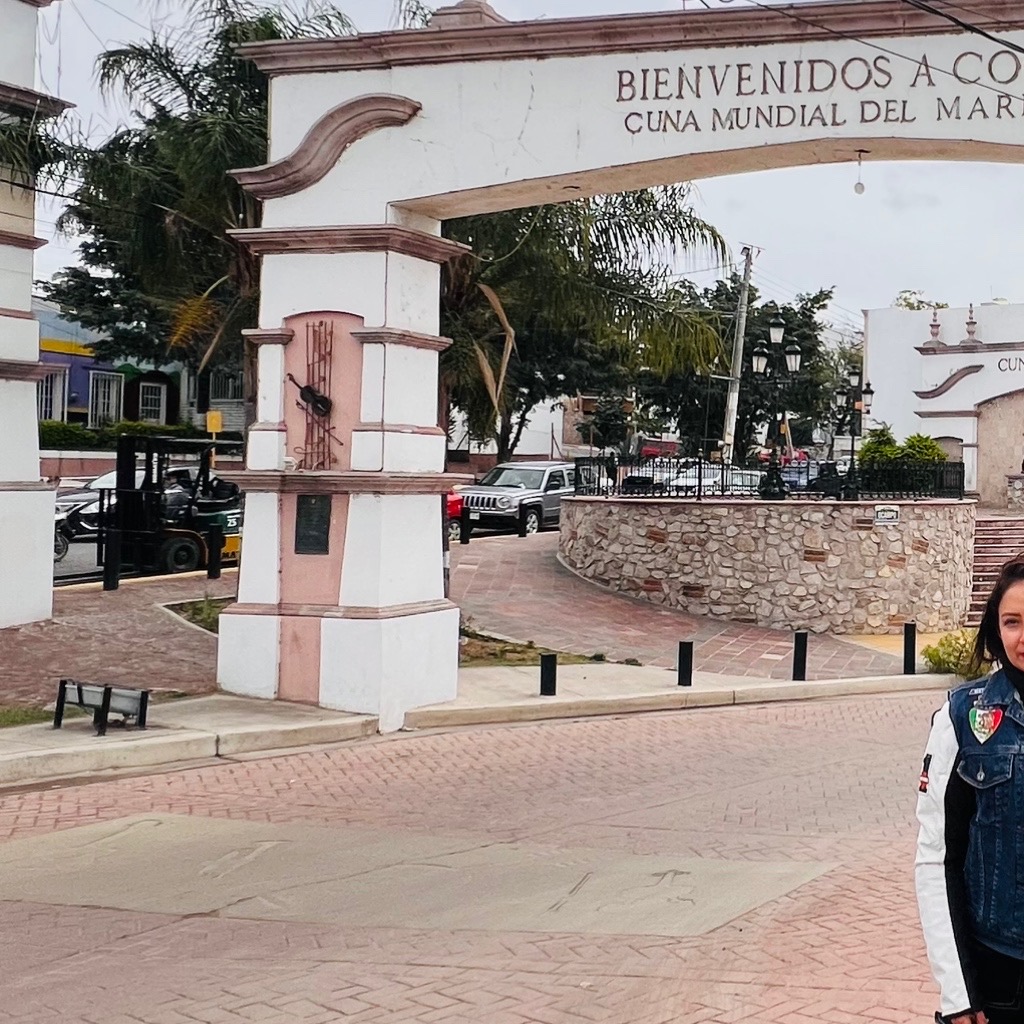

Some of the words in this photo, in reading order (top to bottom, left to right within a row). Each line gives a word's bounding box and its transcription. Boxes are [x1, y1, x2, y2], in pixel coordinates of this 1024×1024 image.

[616, 54, 893, 102] BIENVENIDOS
[909, 53, 936, 88] A
[624, 104, 700, 136] CUNA
[711, 101, 847, 132] MUNDIAL
[859, 100, 917, 124] DEL
